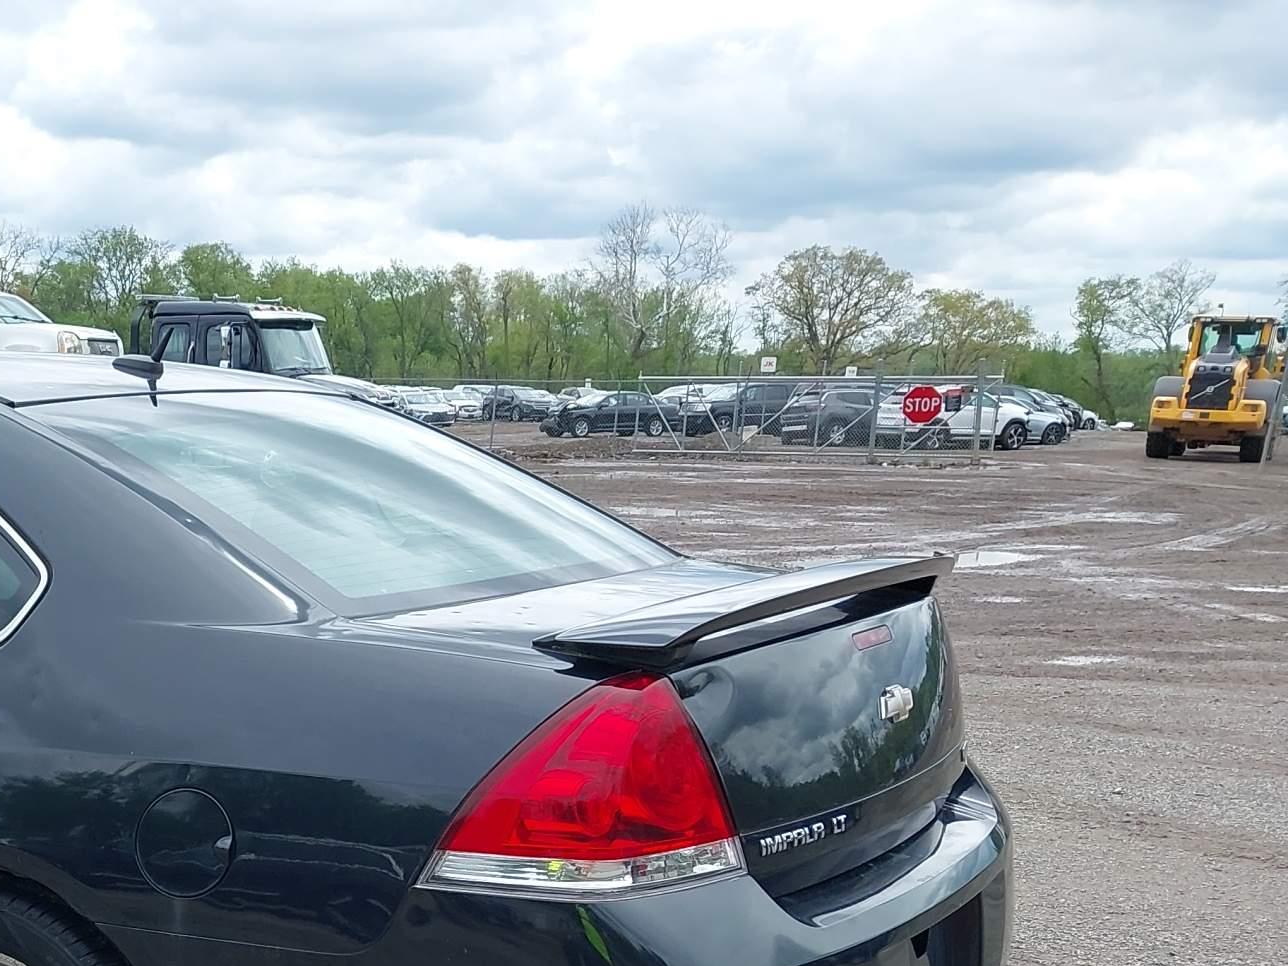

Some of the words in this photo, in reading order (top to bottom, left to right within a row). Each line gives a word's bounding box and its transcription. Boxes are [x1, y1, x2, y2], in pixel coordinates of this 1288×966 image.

[905, 397, 940, 412] STOP
[760, 822, 825, 856] IMPALA
[832, 814, 847, 834] LT
